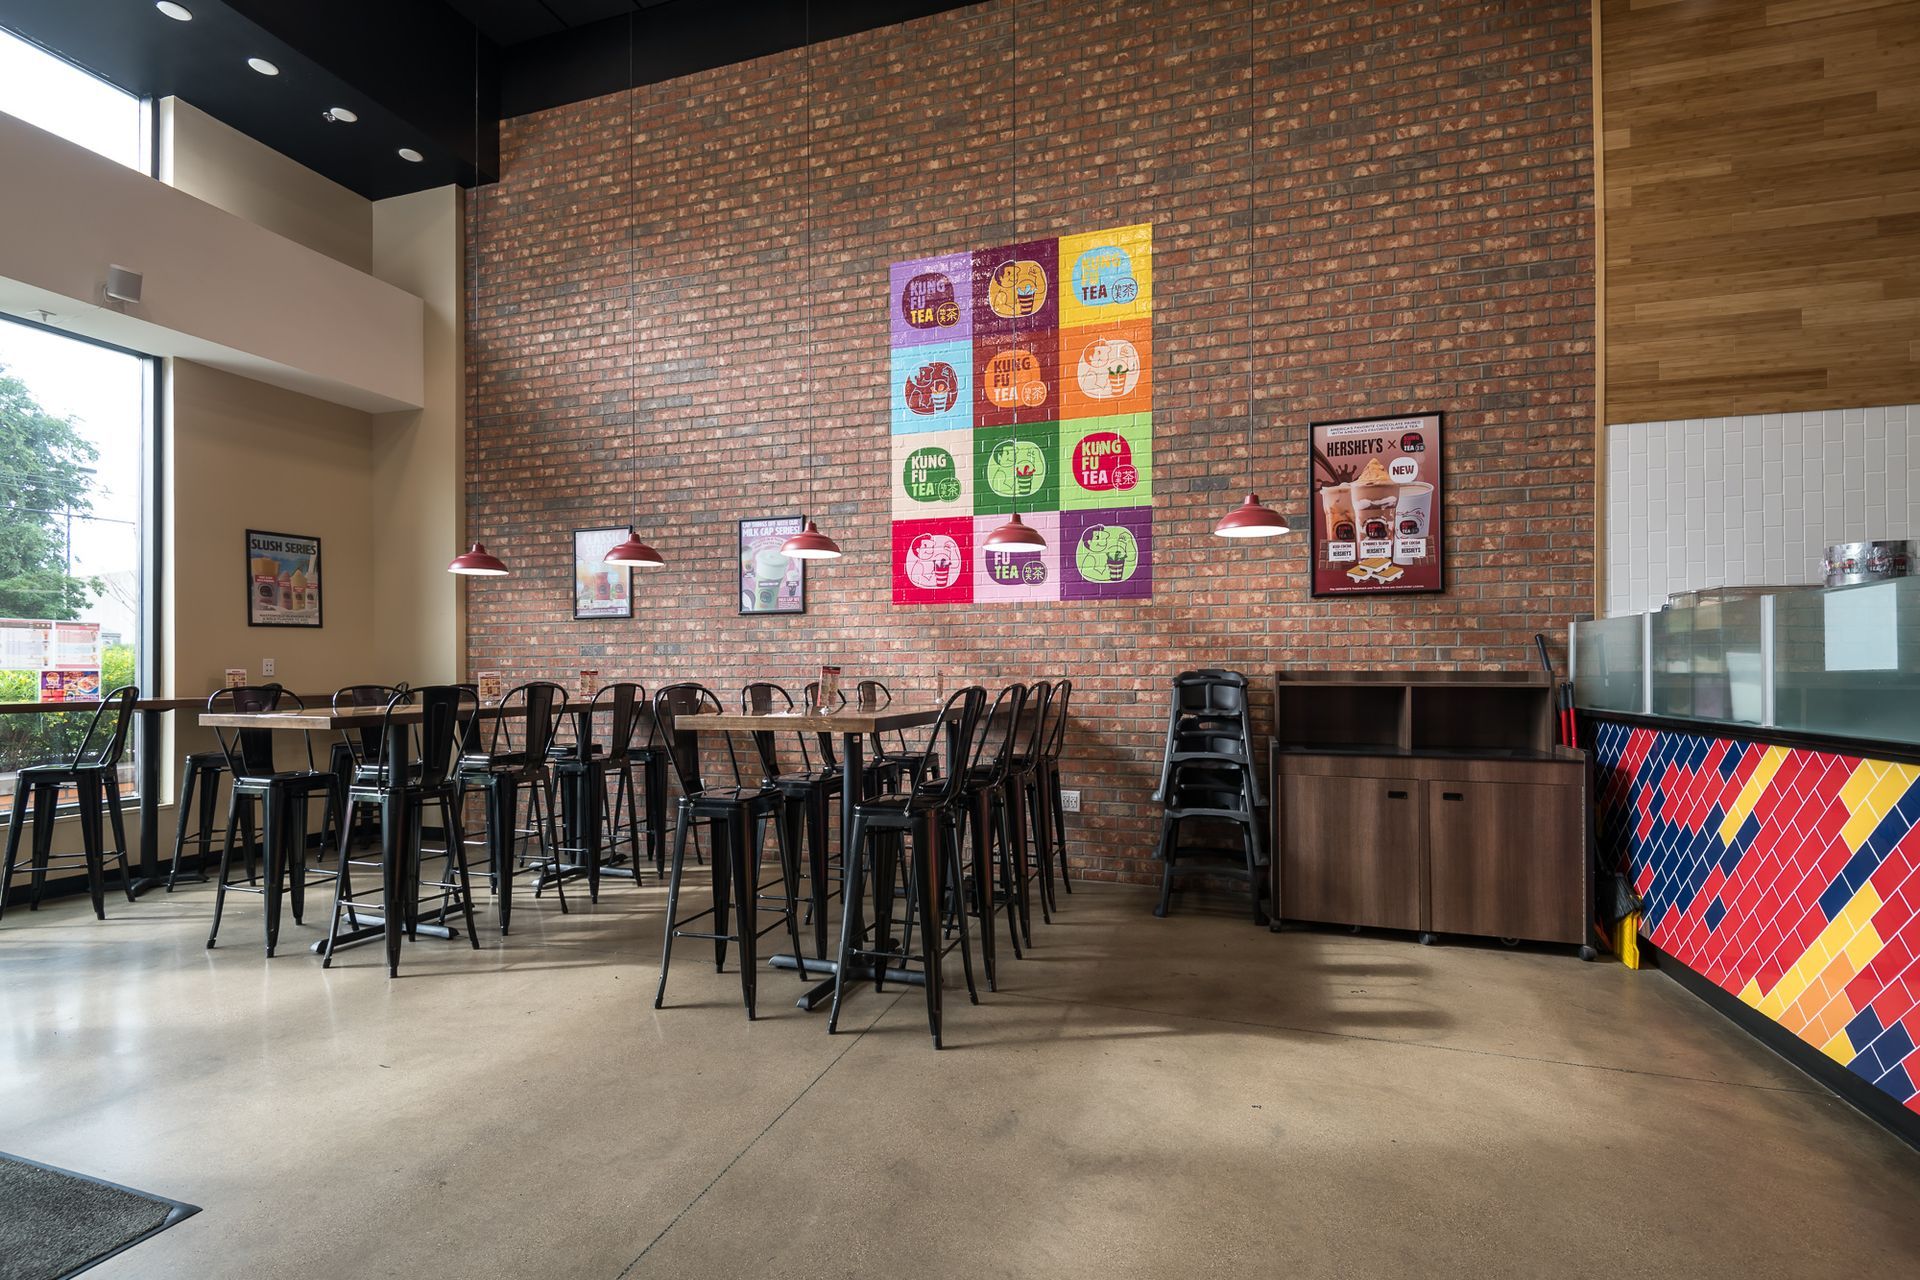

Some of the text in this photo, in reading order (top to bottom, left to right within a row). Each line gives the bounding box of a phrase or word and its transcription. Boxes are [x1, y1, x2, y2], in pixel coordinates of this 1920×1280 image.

[1081, 252, 1121, 270] KUNG
[1081, 270, 1099, 287] FU
[910, 279, 946, 297] KUNG
[1081, 284, 1108, 301] TEA
[910, 296, 926, 310] FU
[910, 308, 934, 324] TEA
[994, 357, 1031, 373] KUNG
[994, 374, 1010, 388] FU
[994, 386, 1019, 402] TEA
[1081, 440, 1122, 457] KUNG
[1327, 438, 1383, 457] HERSHEY'S
[911, 454, 947, 470] KUNG
[1081, 456, 1099, 471] FU
[1392, 465, 1414, 475] NEW
[911, 469, 927, 483] FU
[1081, 469, 1108, 485] TEA
[911, 482, 935, 497] TEA
[741, 527, 759, 537] MILK
[251, 539, 317, 555] SLUSH SERIES
[994, 552, 1011, 565] FU
[994, 564, 1019, 579] TEA
